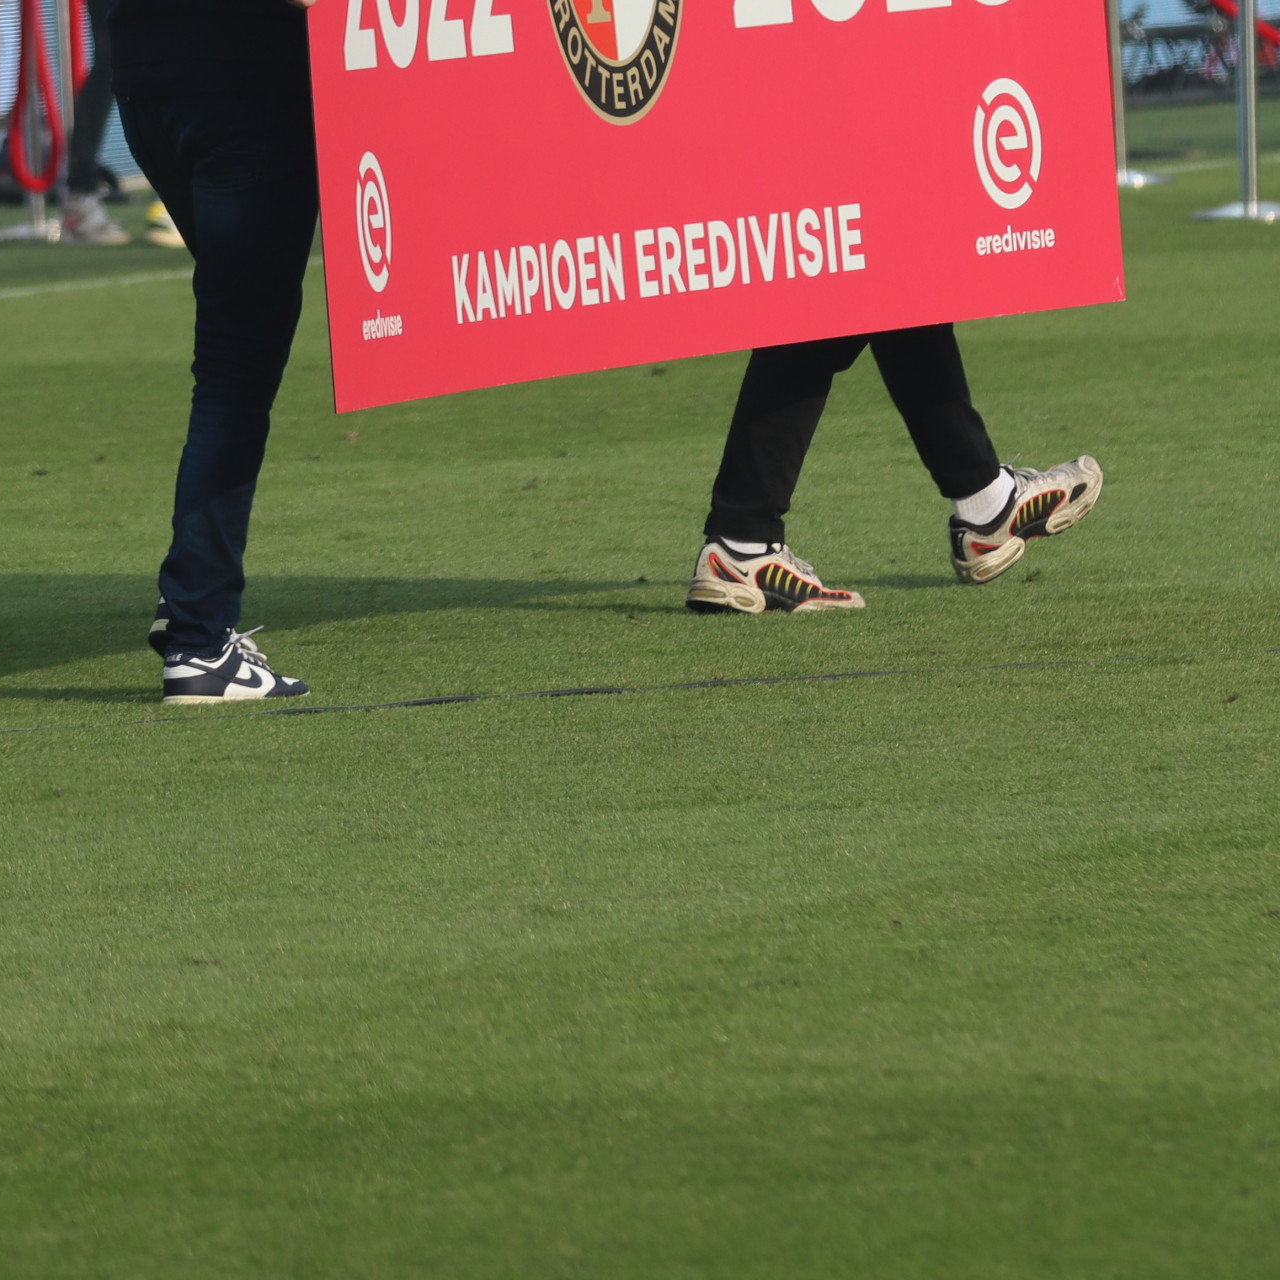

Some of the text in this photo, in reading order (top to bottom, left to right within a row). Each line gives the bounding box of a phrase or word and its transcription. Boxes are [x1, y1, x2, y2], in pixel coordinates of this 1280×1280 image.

[975, 224, 1056, 256] eredivisie
[451, 203, 866, 325] KAMPIOEN EREDIVISIE
[362, 309, 403, 341] eredivisie
